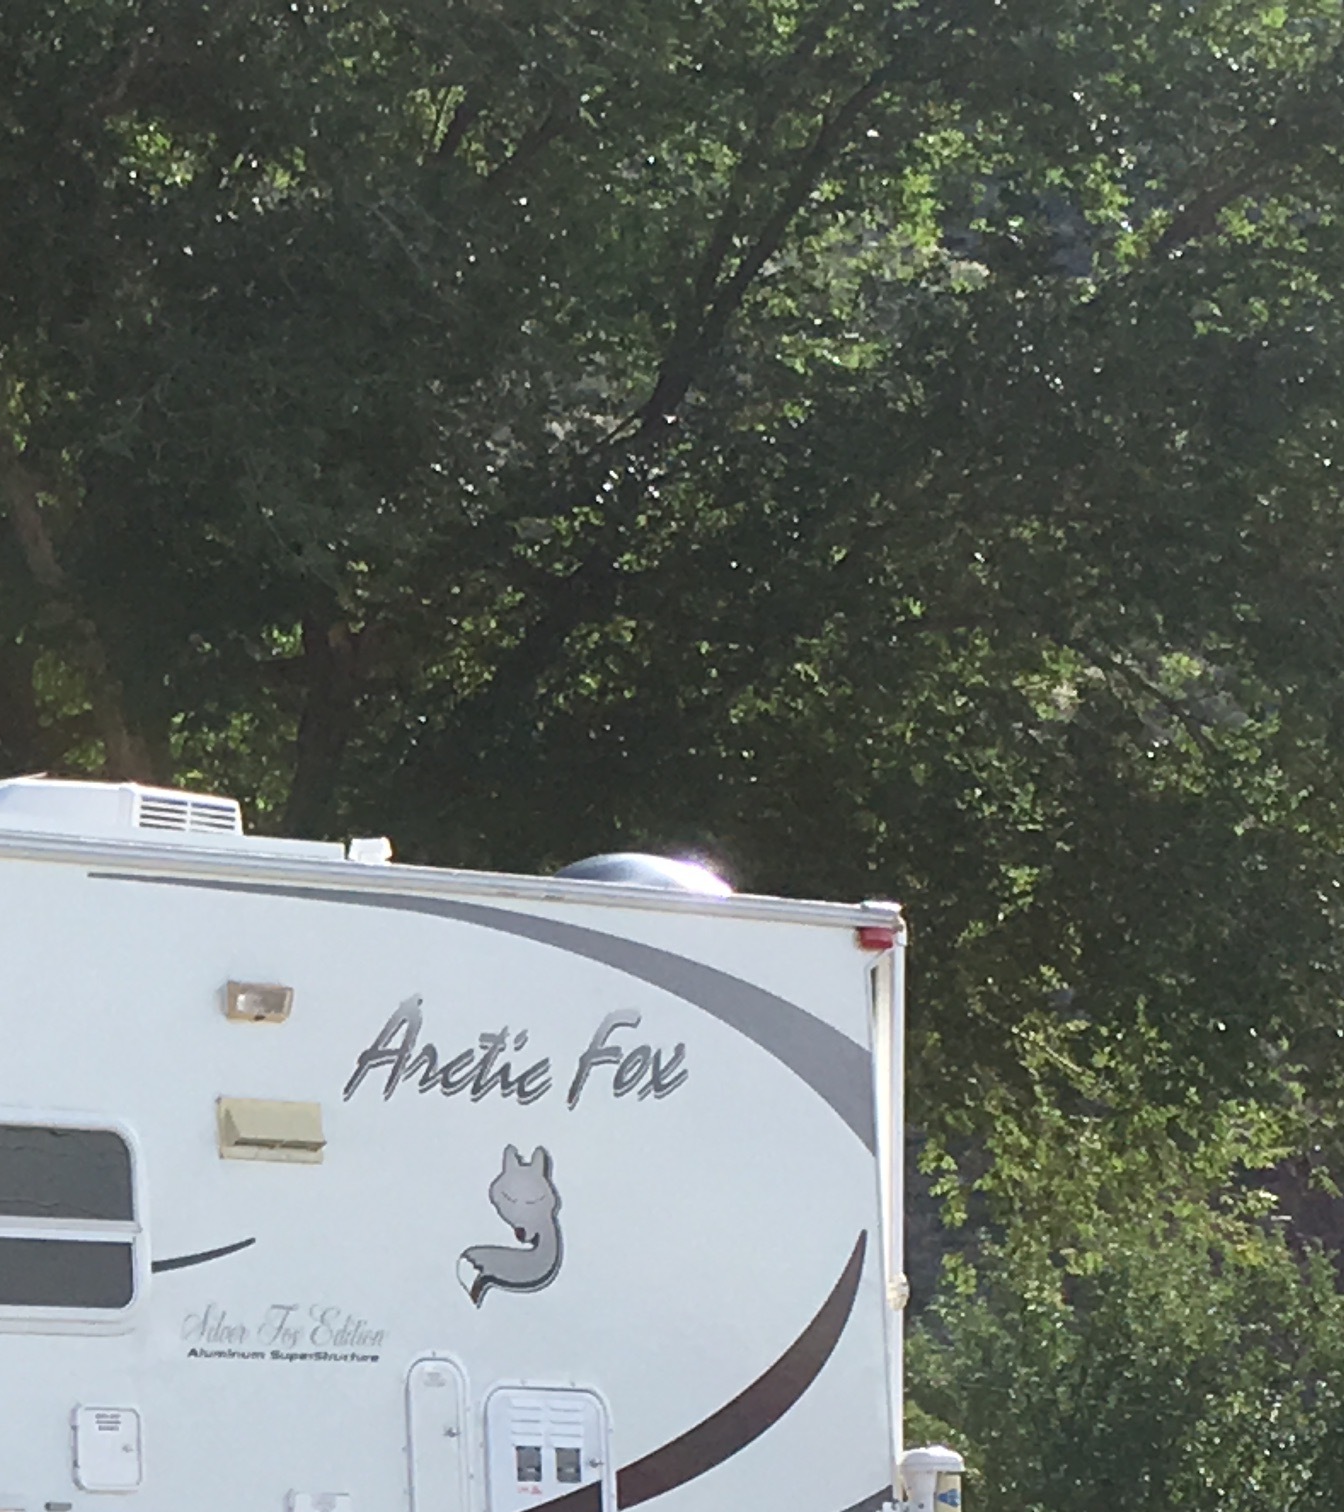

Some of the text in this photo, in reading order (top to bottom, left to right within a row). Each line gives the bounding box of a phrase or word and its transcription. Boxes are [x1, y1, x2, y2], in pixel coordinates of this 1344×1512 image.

[343, 994, 688, 1111] Arctic Fox
[309, 1303, 388, 1347] Edition
[186, 1348, 266, 1360] Aluminum
